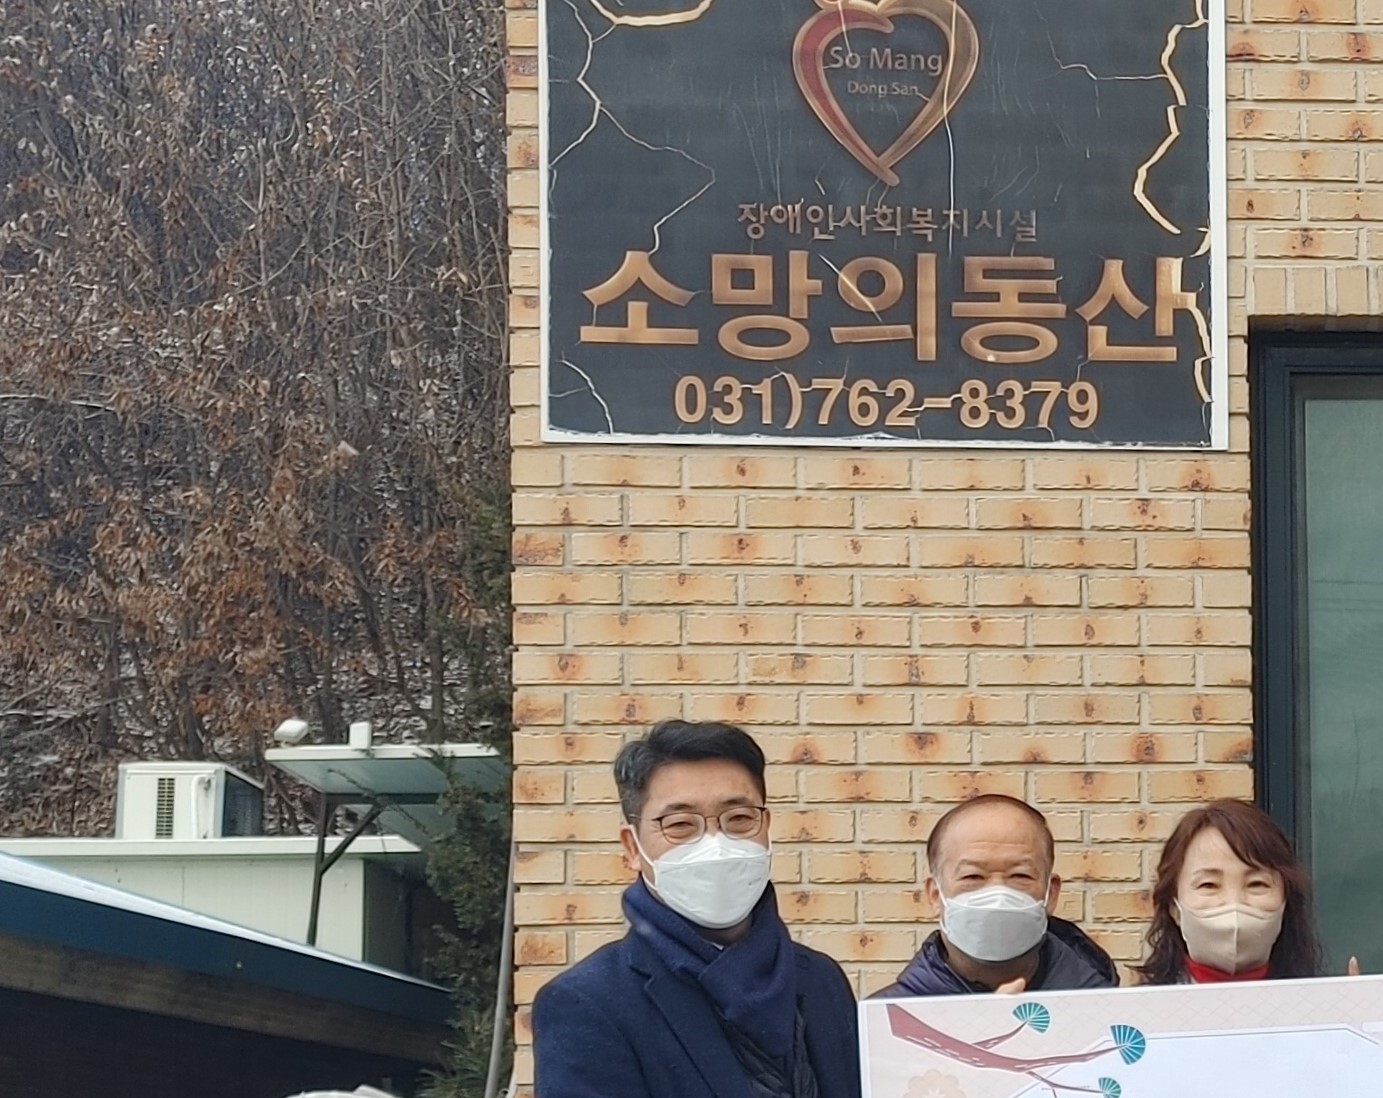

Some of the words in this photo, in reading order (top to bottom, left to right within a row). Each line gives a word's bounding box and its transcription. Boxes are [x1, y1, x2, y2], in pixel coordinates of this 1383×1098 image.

[830, 46, 860, 69] So
[869, 47, 943, 77] Mang
[847, 81, 887, 98] Dong
[890, 81, 920, 96] San
[737, 202, 1038, 243] 장애인사회복지시설
[579, 249, 1197, 363] 소망의동산
[674, 372, 1099, 430] 031)762-8379
